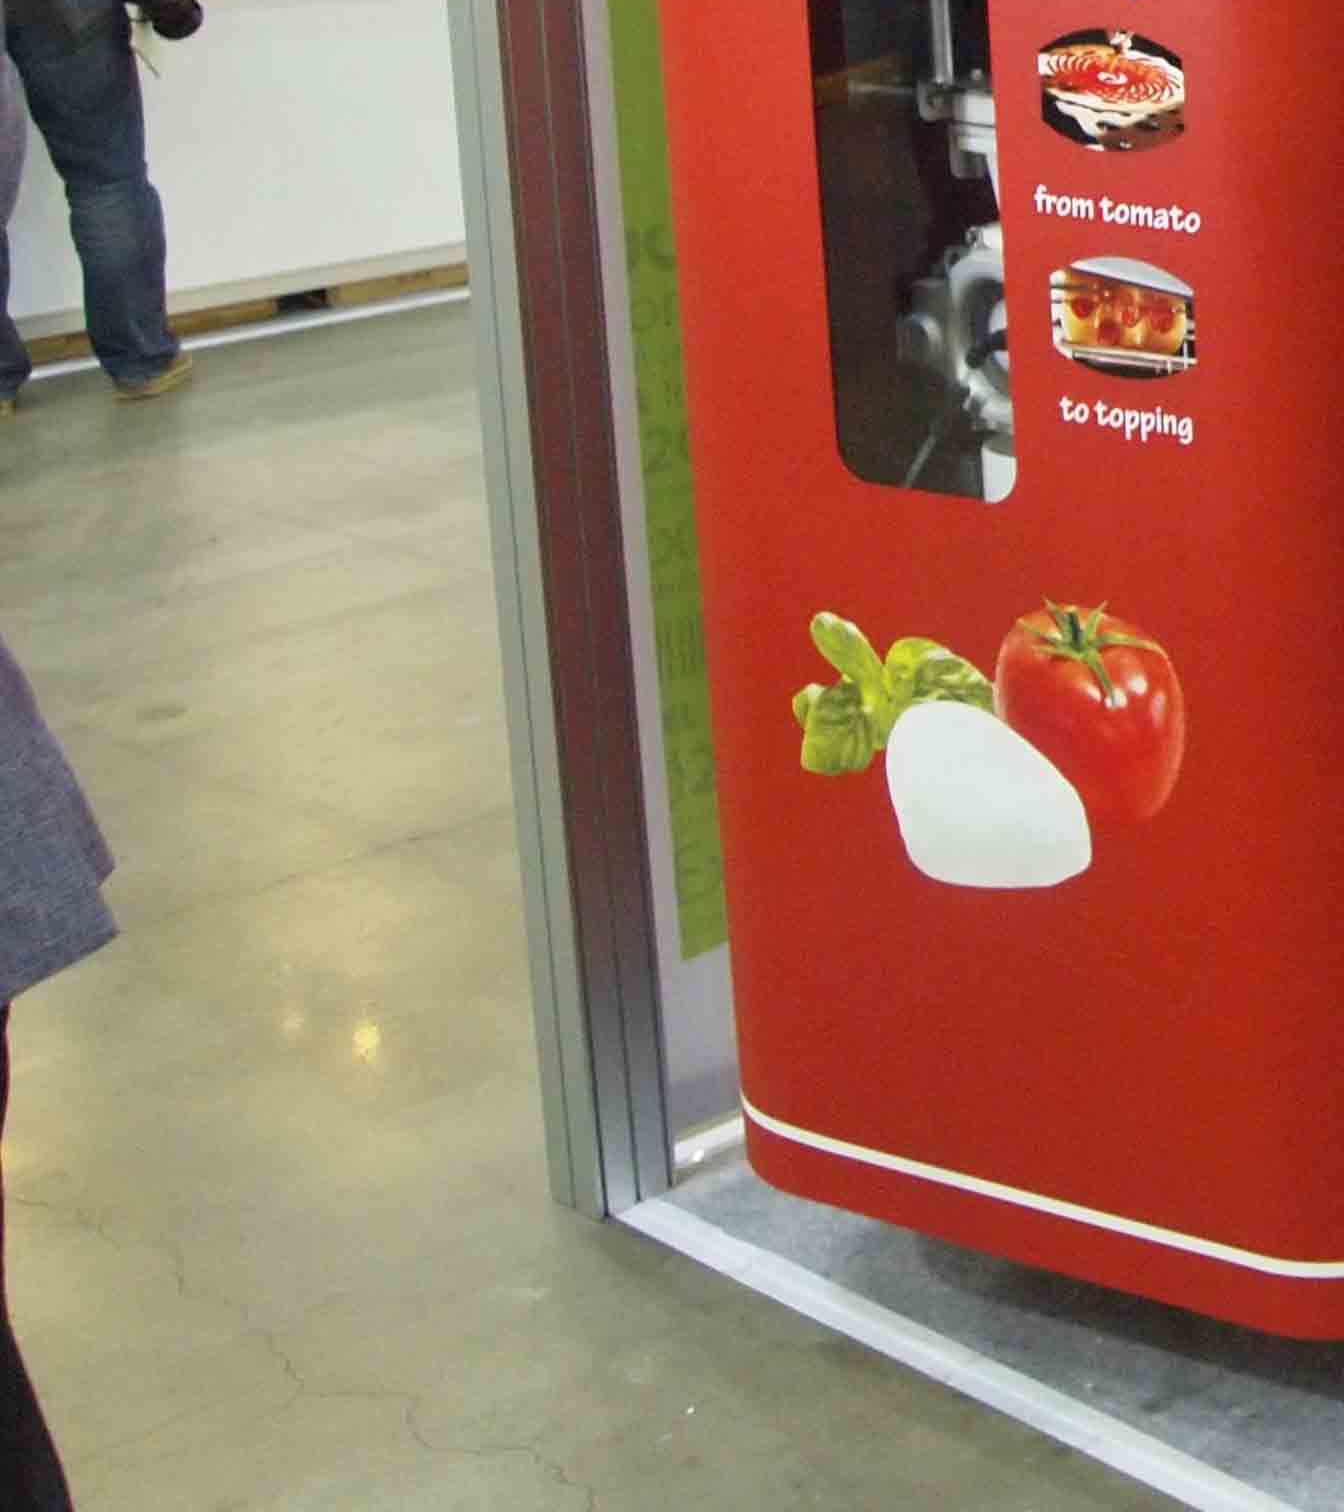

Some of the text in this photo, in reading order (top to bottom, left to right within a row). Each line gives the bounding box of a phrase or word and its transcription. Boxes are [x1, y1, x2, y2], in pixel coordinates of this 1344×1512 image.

[1034, 185, 1201, 233] from tomato
[1059, 396, 1194, 445] to topping
